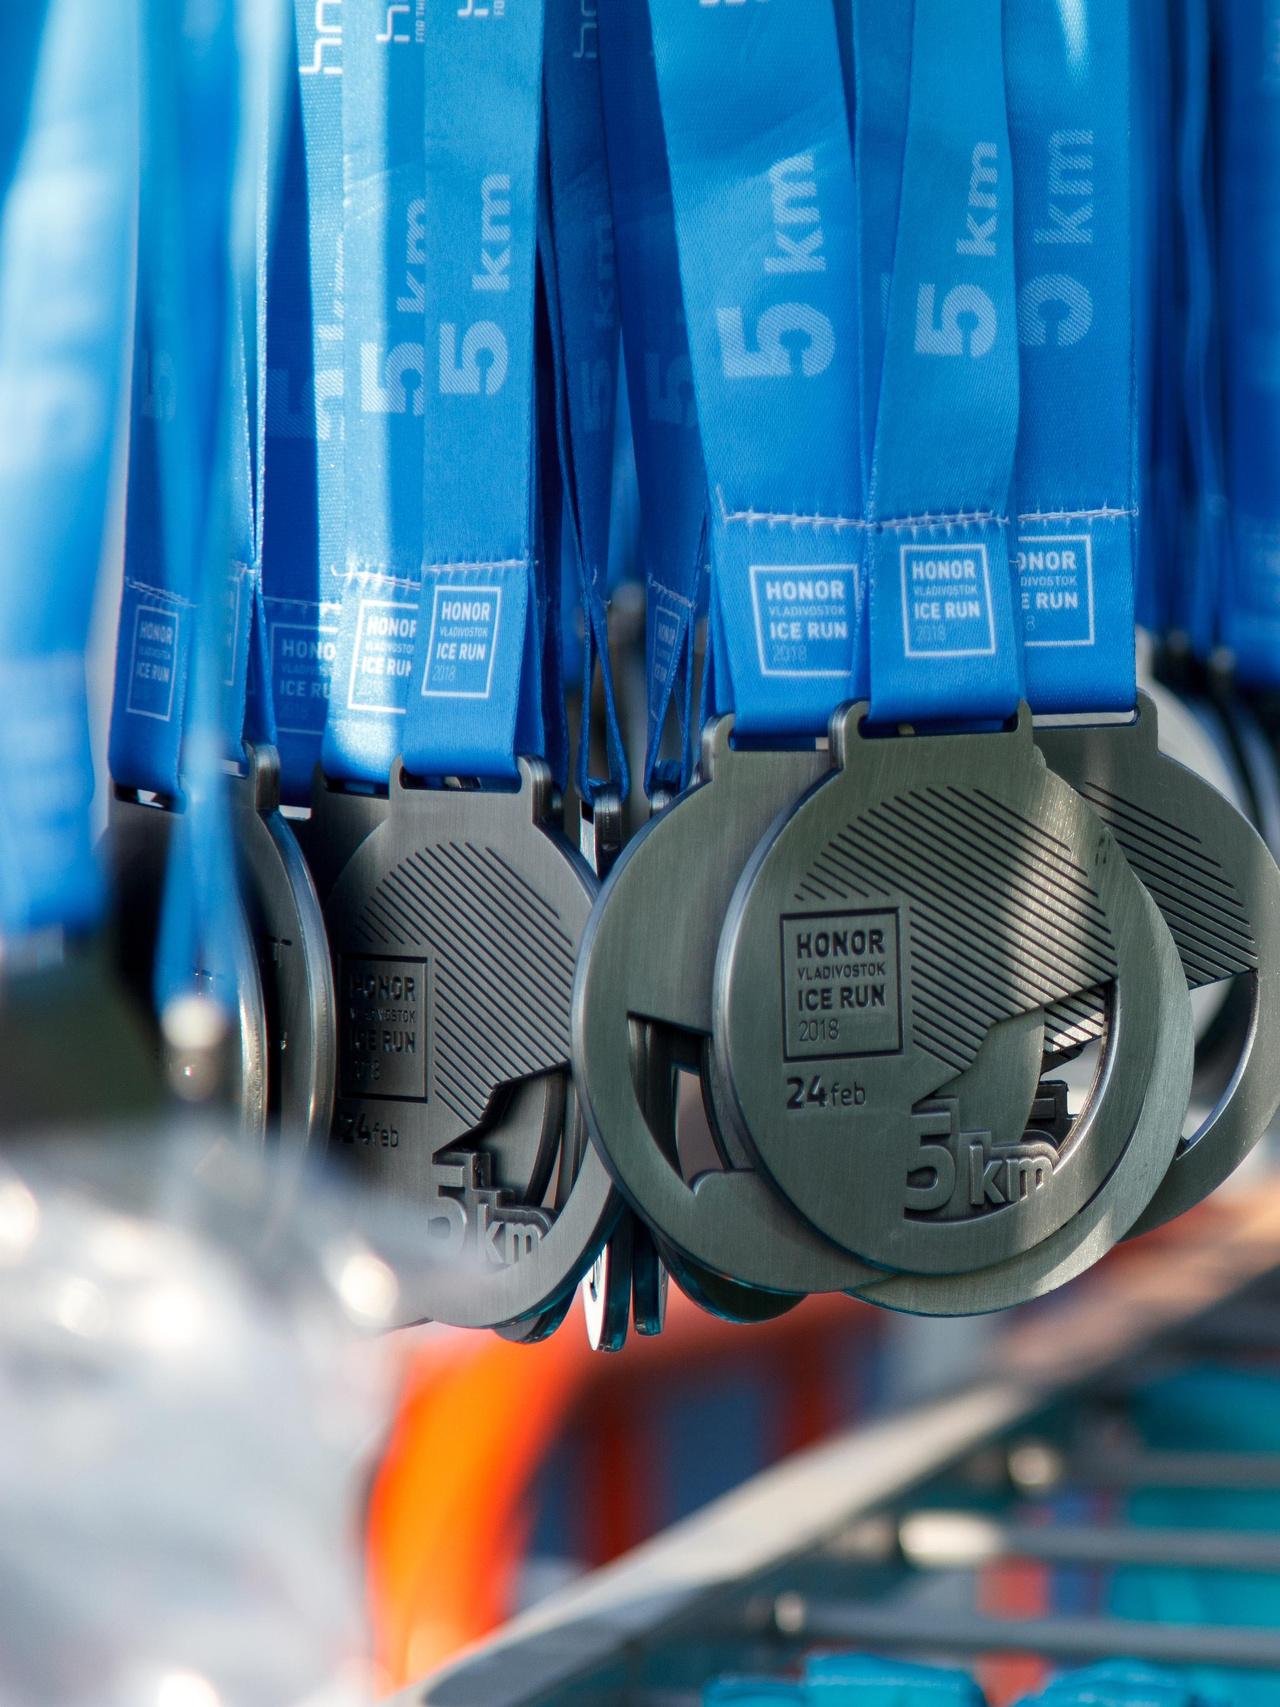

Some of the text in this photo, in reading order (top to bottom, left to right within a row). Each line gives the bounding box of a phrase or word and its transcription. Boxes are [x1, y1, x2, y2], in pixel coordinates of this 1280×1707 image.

[1033, 129, 1094, 244] km
[913, 141, 998, 358] 5 km
[715, 153, 836, 378] 5 km
[439, 173, 511, 395] 5 km
[359, 341, 425, 417] 5
[911, 559, 976, 580] HONOR
[765, 579, 846, 601] HONOR
[912, 584, 978, 597] VLADIVOSTOK
[1035, 591, 1079, 610] RUN
[441, 600, 492, 622] HONOR
[767, 604, 846, 618] VLADIVOSTOK
[913, 600, 981, 620] ICE RUN
[140, 621, 173, 645] HONOR
[439, 625, 489, 638] VLADIVOSTOK
[769, 620, 849, 641] ICE RUN
[282, 638, 336, 661] HONO
[435, 642, 486, 661] ICE RUN
[360, 655, 385, 676] ICE
[279, 679, 307, 698] ICE
[796, 928, 886, 960] HONOR
[797, 961, 887, 982] VLADIVOSTOK
[351, 973, 417, 1003] HONOR
[798, 984, 886, 1012] ICE RUN
[799, 1018, 840, 1042] 2018
[381, 1030, 417, 1055] RUN
[786, 1074, 867, 1111] 24 feb
[370, 1119, 400, 1149] feb
[903, 1108, 957, 1214] 5
[968, 1143, 1056, 1207] km
